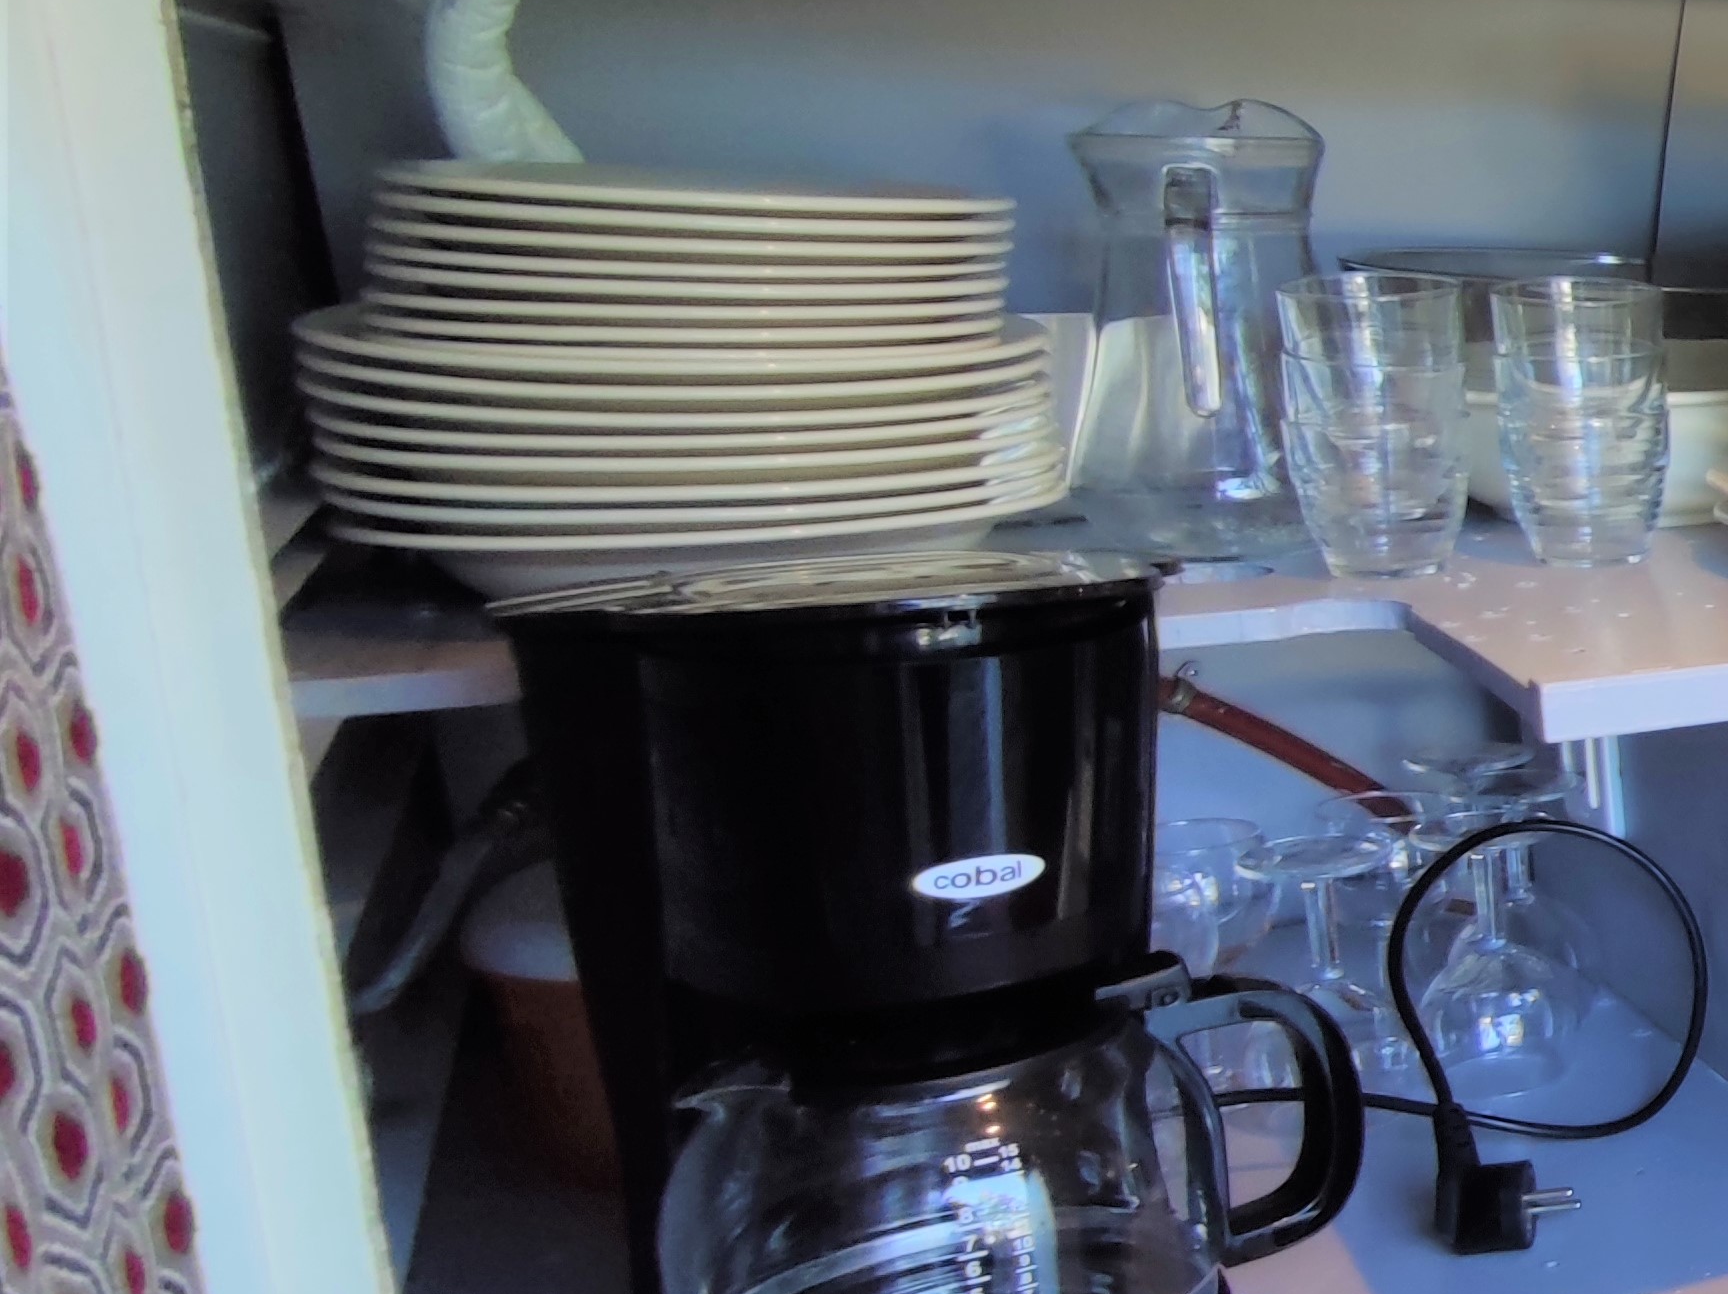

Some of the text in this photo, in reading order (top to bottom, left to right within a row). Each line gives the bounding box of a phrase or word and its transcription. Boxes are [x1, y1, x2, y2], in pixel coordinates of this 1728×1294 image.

[934, 860, 1022, 890] cobal
[944, 1154, 971, 1174] 10
[965, 1260, 982, 1278] 6
